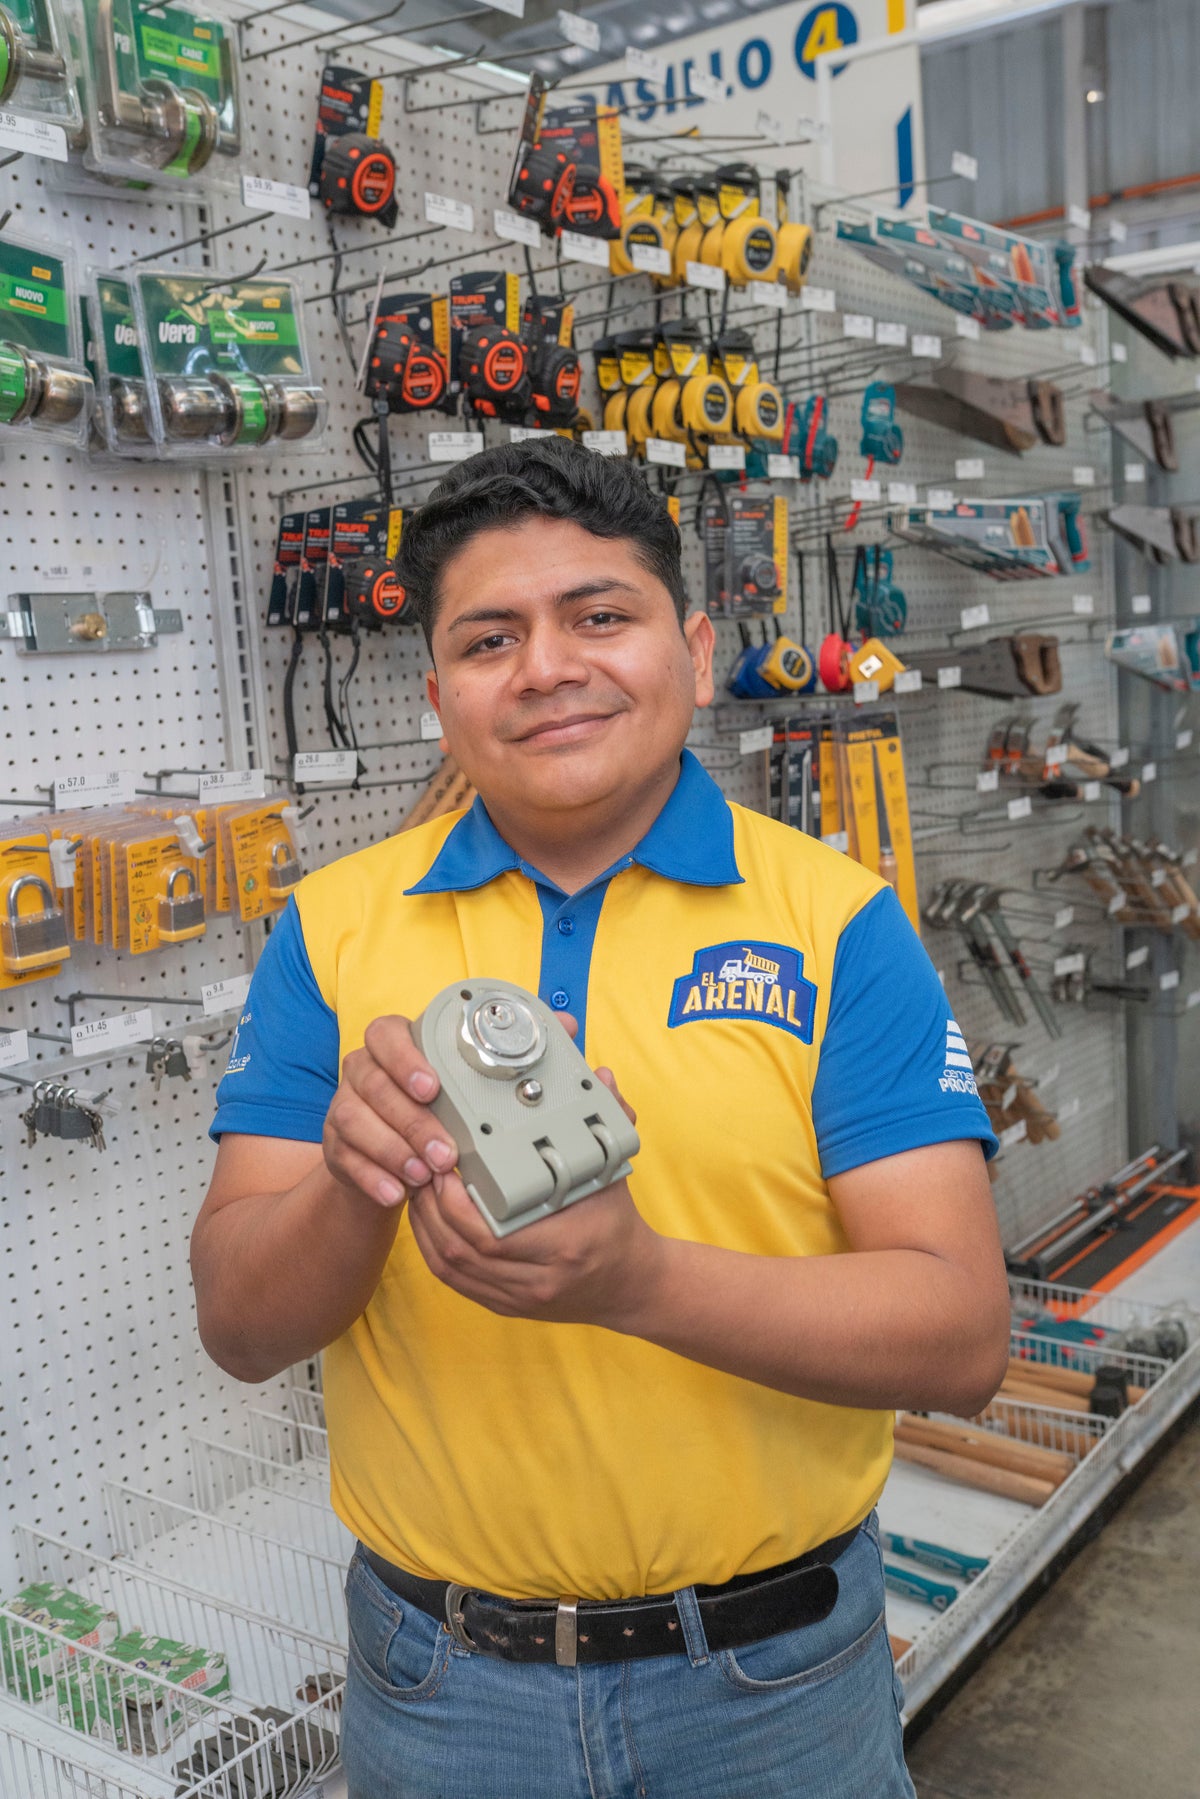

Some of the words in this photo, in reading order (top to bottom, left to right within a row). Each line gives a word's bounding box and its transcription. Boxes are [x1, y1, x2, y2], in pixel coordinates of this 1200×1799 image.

[802, 8, 845, 63] 4
[15, 286, 44, 304] NUOVO
[159, 321, 196, 344] Vera
[67, 776, 86, 787] 57.0
[213, 982, 224, 993] 9.8
[701, 971, 717, 987] EL
[682, 979, 802, 1028] ARENAL
[85, 1021, 107, 1034] 11.45
